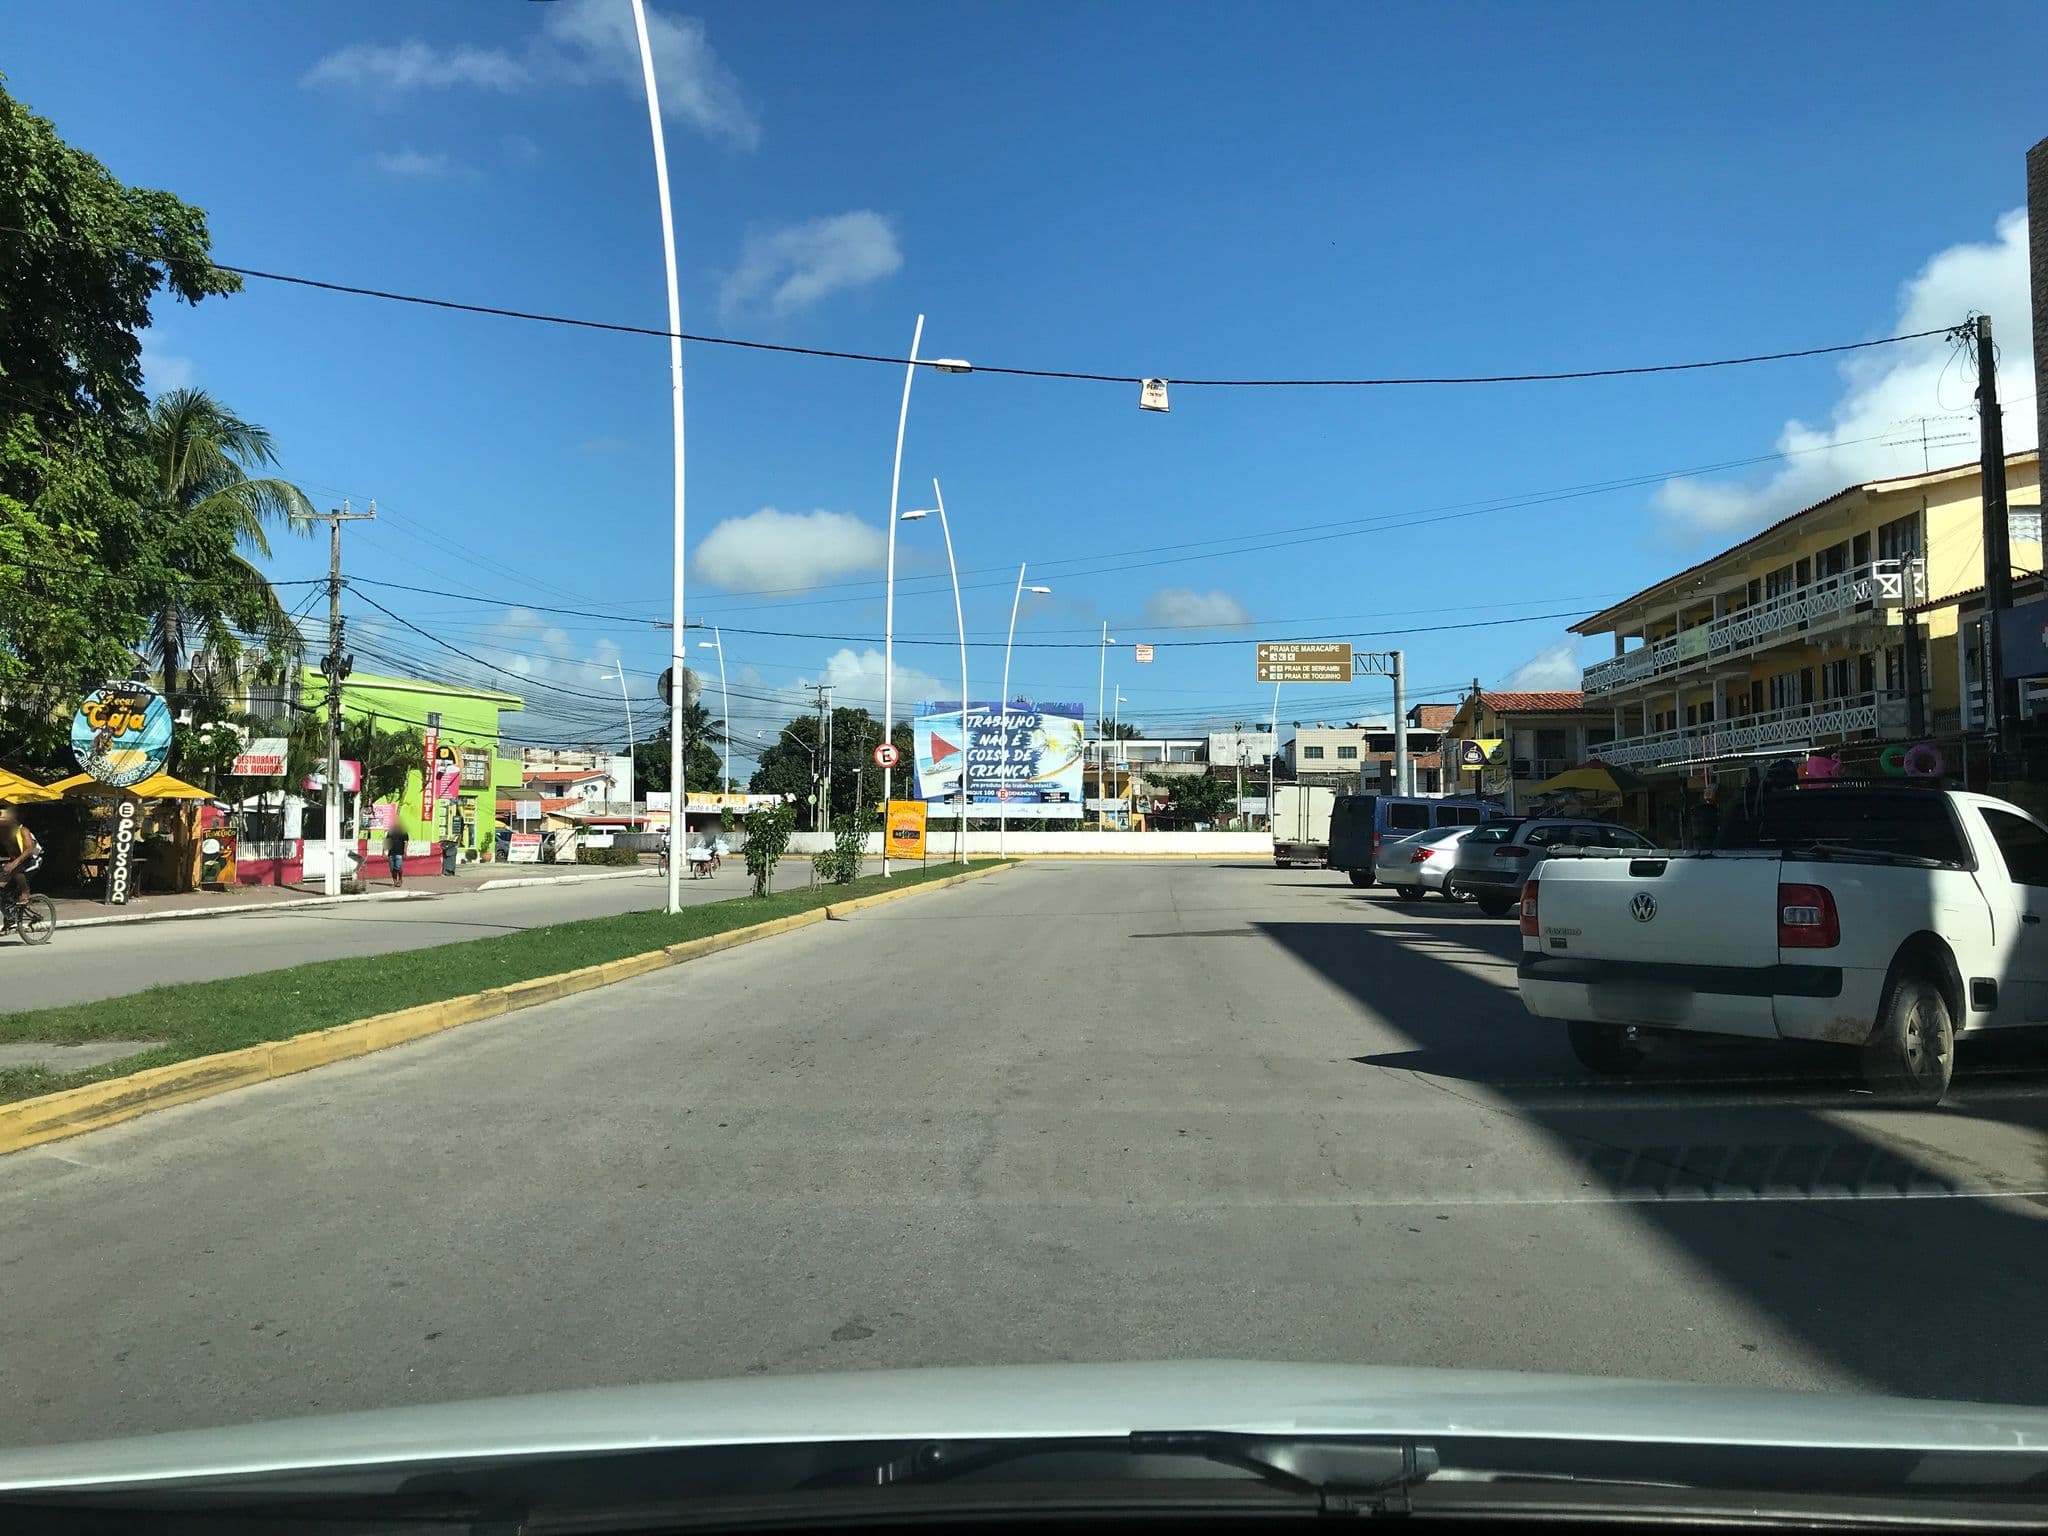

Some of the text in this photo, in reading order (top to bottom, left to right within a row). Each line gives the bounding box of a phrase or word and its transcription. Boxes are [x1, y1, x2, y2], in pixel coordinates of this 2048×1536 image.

[1269, 645, 1290, 653] PRAIA
[1291, 645, 1300, 653] DE
[967, 715, 1035, 730] TRABALHO
[979, 729, 1023, 747] NÃO É
[967, 750, 1033, 762] COISA DE
[112, 818, 134, 903] POUSADA
